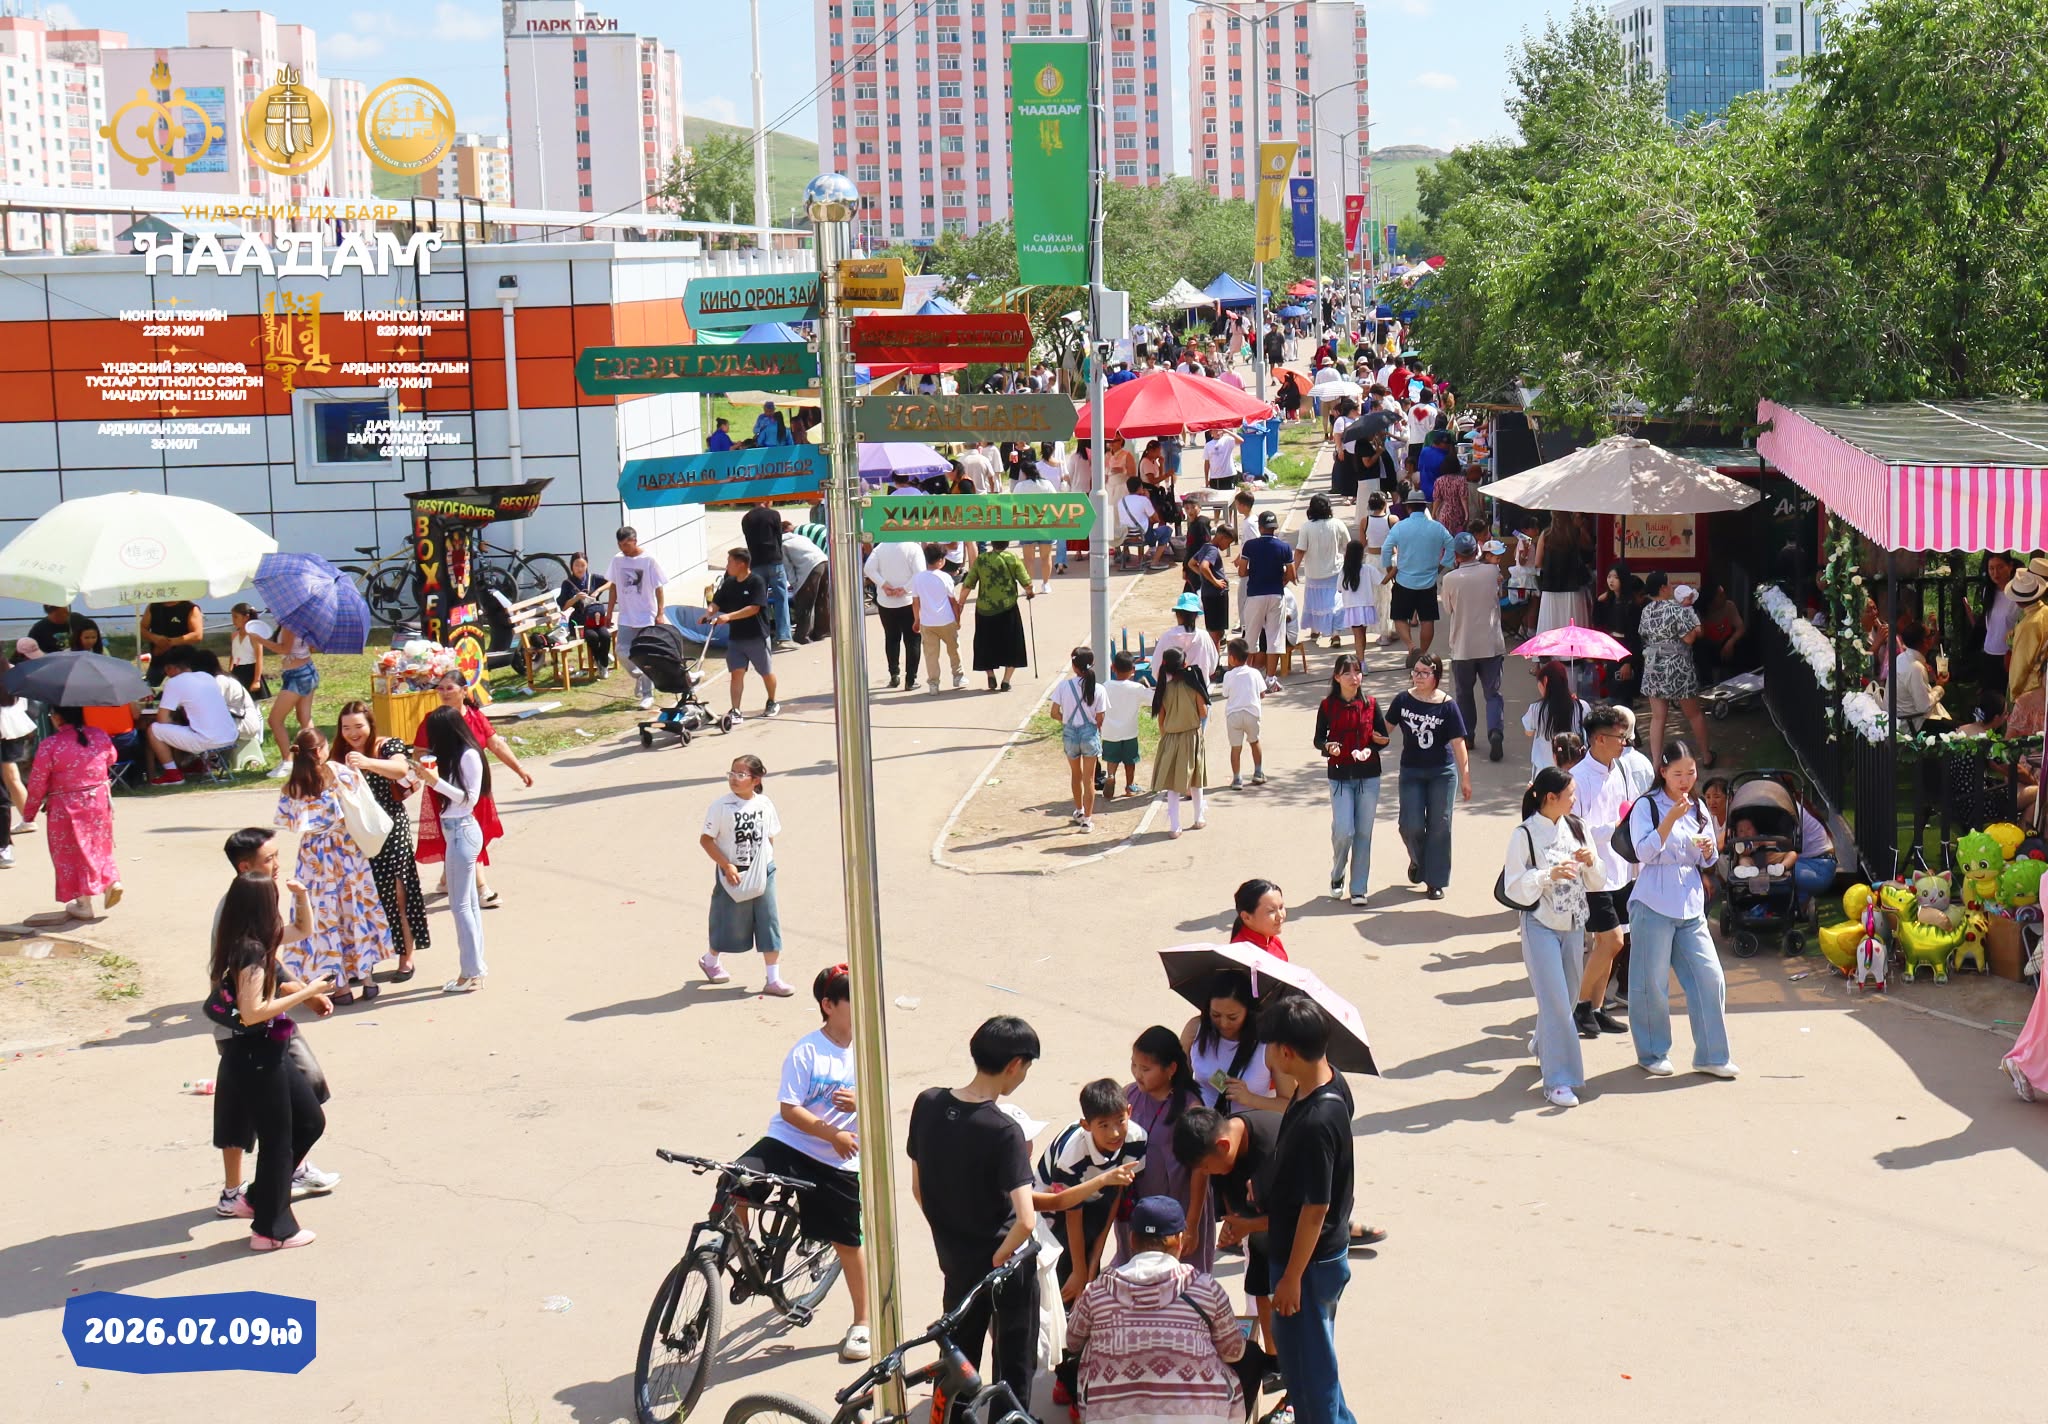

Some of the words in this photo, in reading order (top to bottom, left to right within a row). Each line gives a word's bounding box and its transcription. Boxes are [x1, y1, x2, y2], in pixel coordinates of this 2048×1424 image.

[526, 19, 572, 32] ПАРК
[576, 19, 618, 31] ТАУН
[1018, 104, 1082, 116] НААДАМ
[1033, 232, 1073, 243] САЙХАН
[1023, 243, 1085, 254] НААДААРАЙ
[700, 289, 741, 311] КИНО
[745, 286, 786, 308] ОРОН
[789, 279, 819, 306] ЗАЙ
[594, 354, 689, 378] ГЭРЭЛТ
[698, 351, 801, 376] ГУДАМЖ
[886, 403, 961, 428] УСАН
[970, 404, 1048, 428] ПАРК
[637, 470, 696, 490] ДАРХАН
[700, 468, 717, 482] 60
[416, 499, 444, 515] BEST
[444, 501, 459, 518] OF
[459, 503, 497, 520] BOXER
[499, 495, 529, 510] BEST
[882, 502, 1001, 528] ХИЙМЭЛ
[1012, 503, 1086, 527] НУУР
[1645, 521, 1669, 531] Italian
[415, 515, 442, 645] BOXER
[119, 586, 180, 601] 让身心微笑
